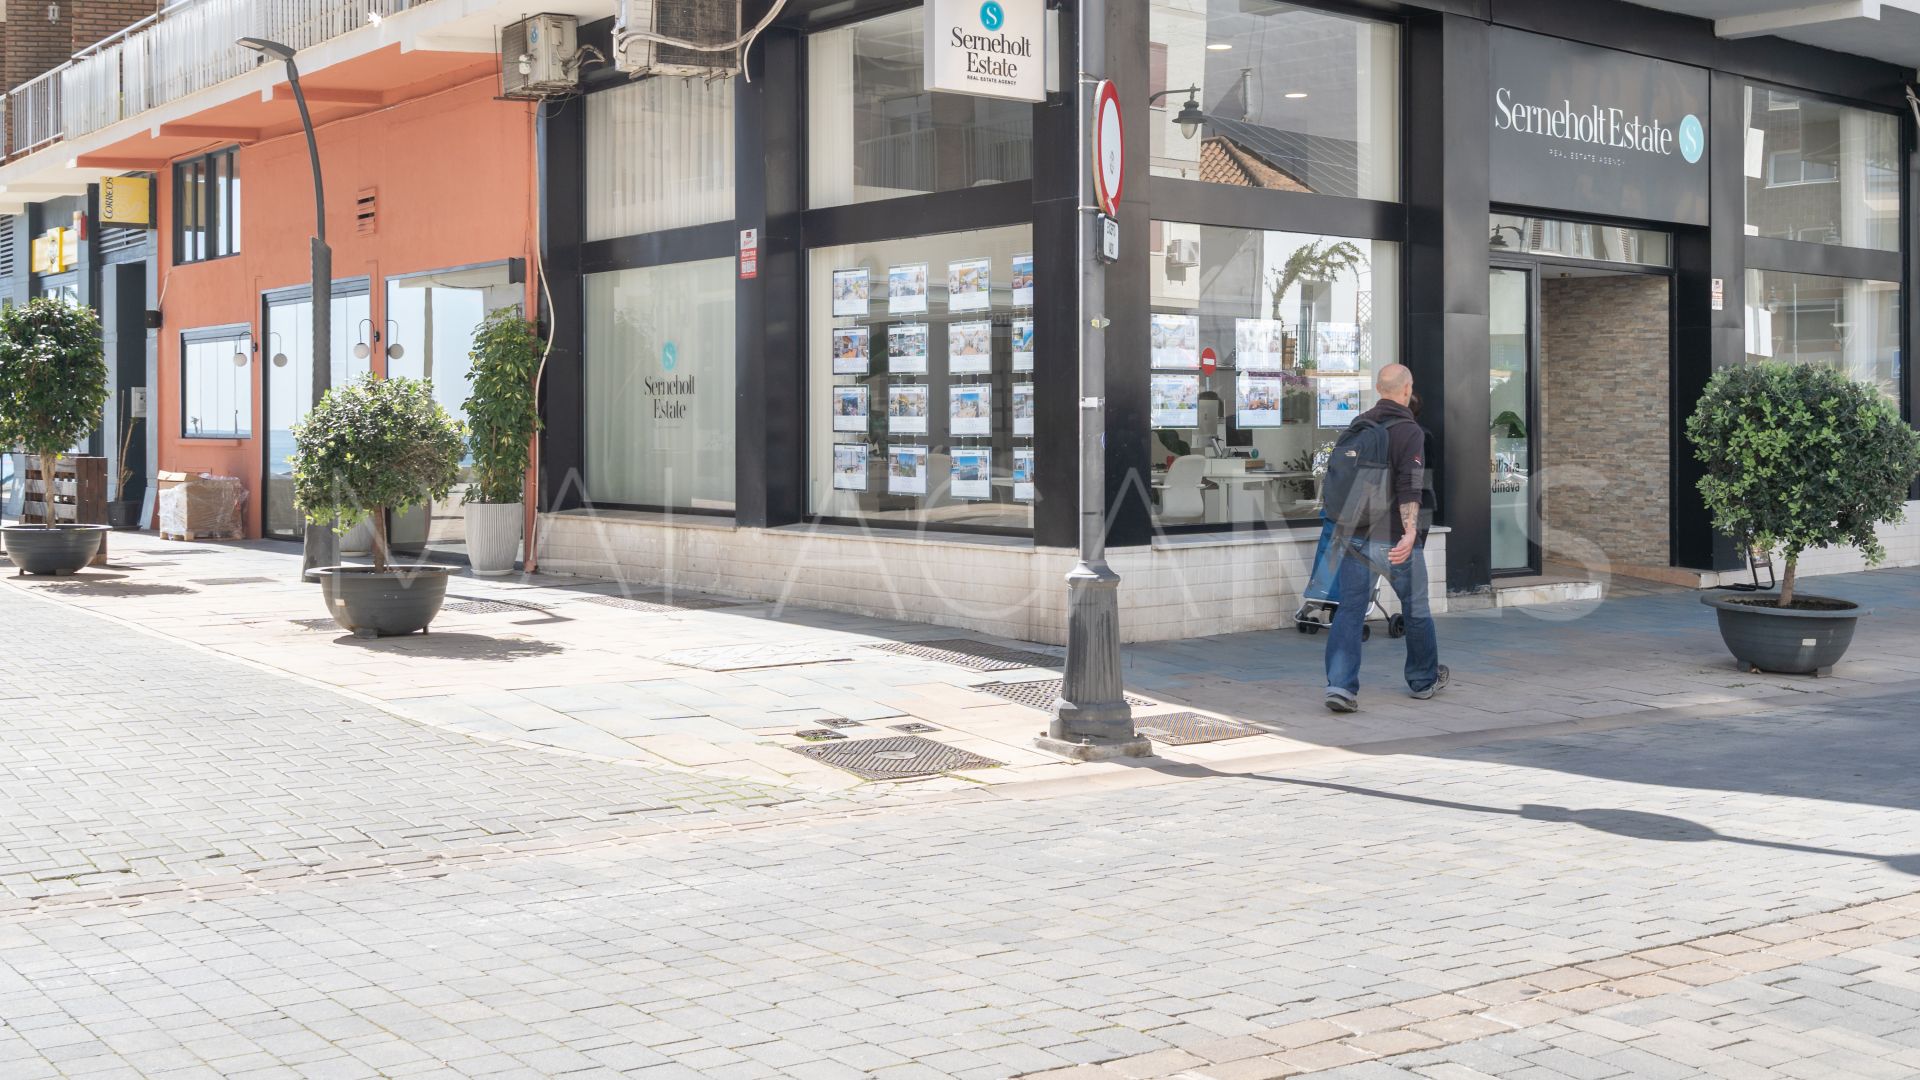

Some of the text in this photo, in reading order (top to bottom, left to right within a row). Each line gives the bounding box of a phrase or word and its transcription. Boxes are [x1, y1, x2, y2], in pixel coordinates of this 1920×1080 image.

[951, 26, 1031, 58] Serneholt
[966, 51, 1018, 78] Estate
[980, 76, 997, 84] ESTATE
[1495, 87, 1672, 155] Serneholt Estate
[1570, 151, 1596, 163] ESTATE
[644, 374, 695, 396] Serneholt
[654, 398, 686, 419] Estate
[1491, 479, 1520, 493] dinava
